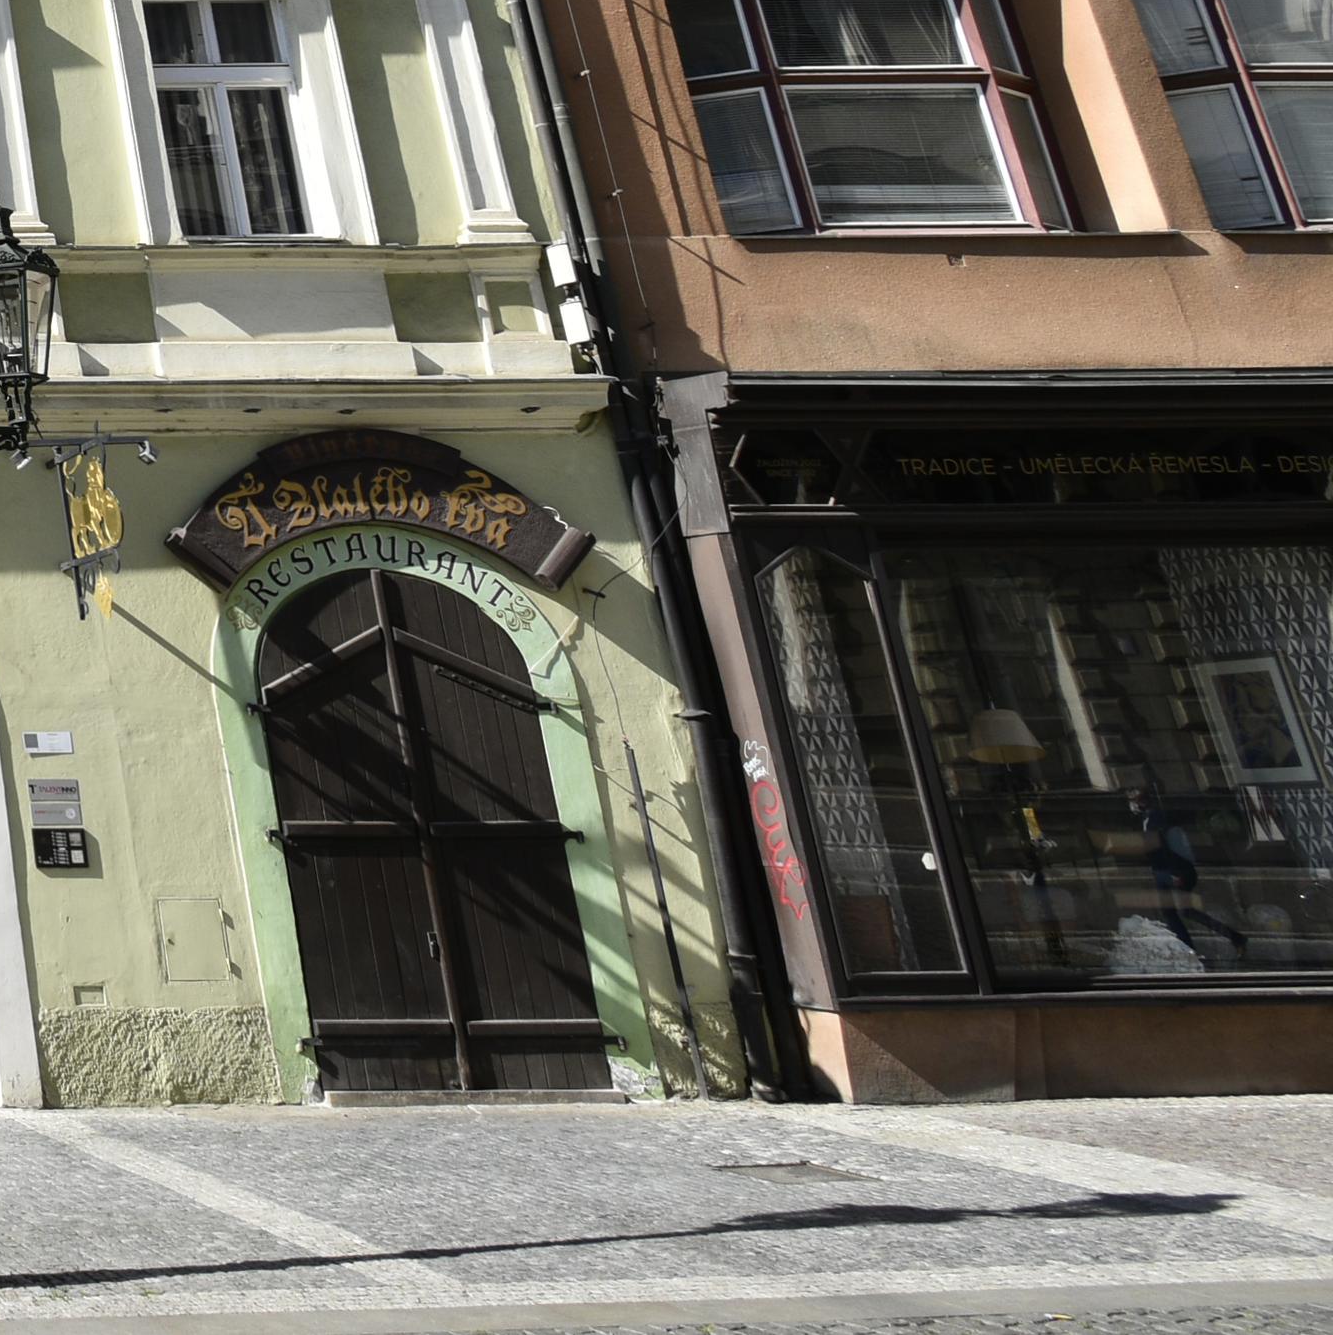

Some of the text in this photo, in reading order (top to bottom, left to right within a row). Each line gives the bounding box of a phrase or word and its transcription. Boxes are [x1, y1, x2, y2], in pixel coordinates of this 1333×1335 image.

[894, 457, 998, 475] TRADICE
[215, 472, 277, 548] U
[244, 533, 513, 609] RESTAURANT
